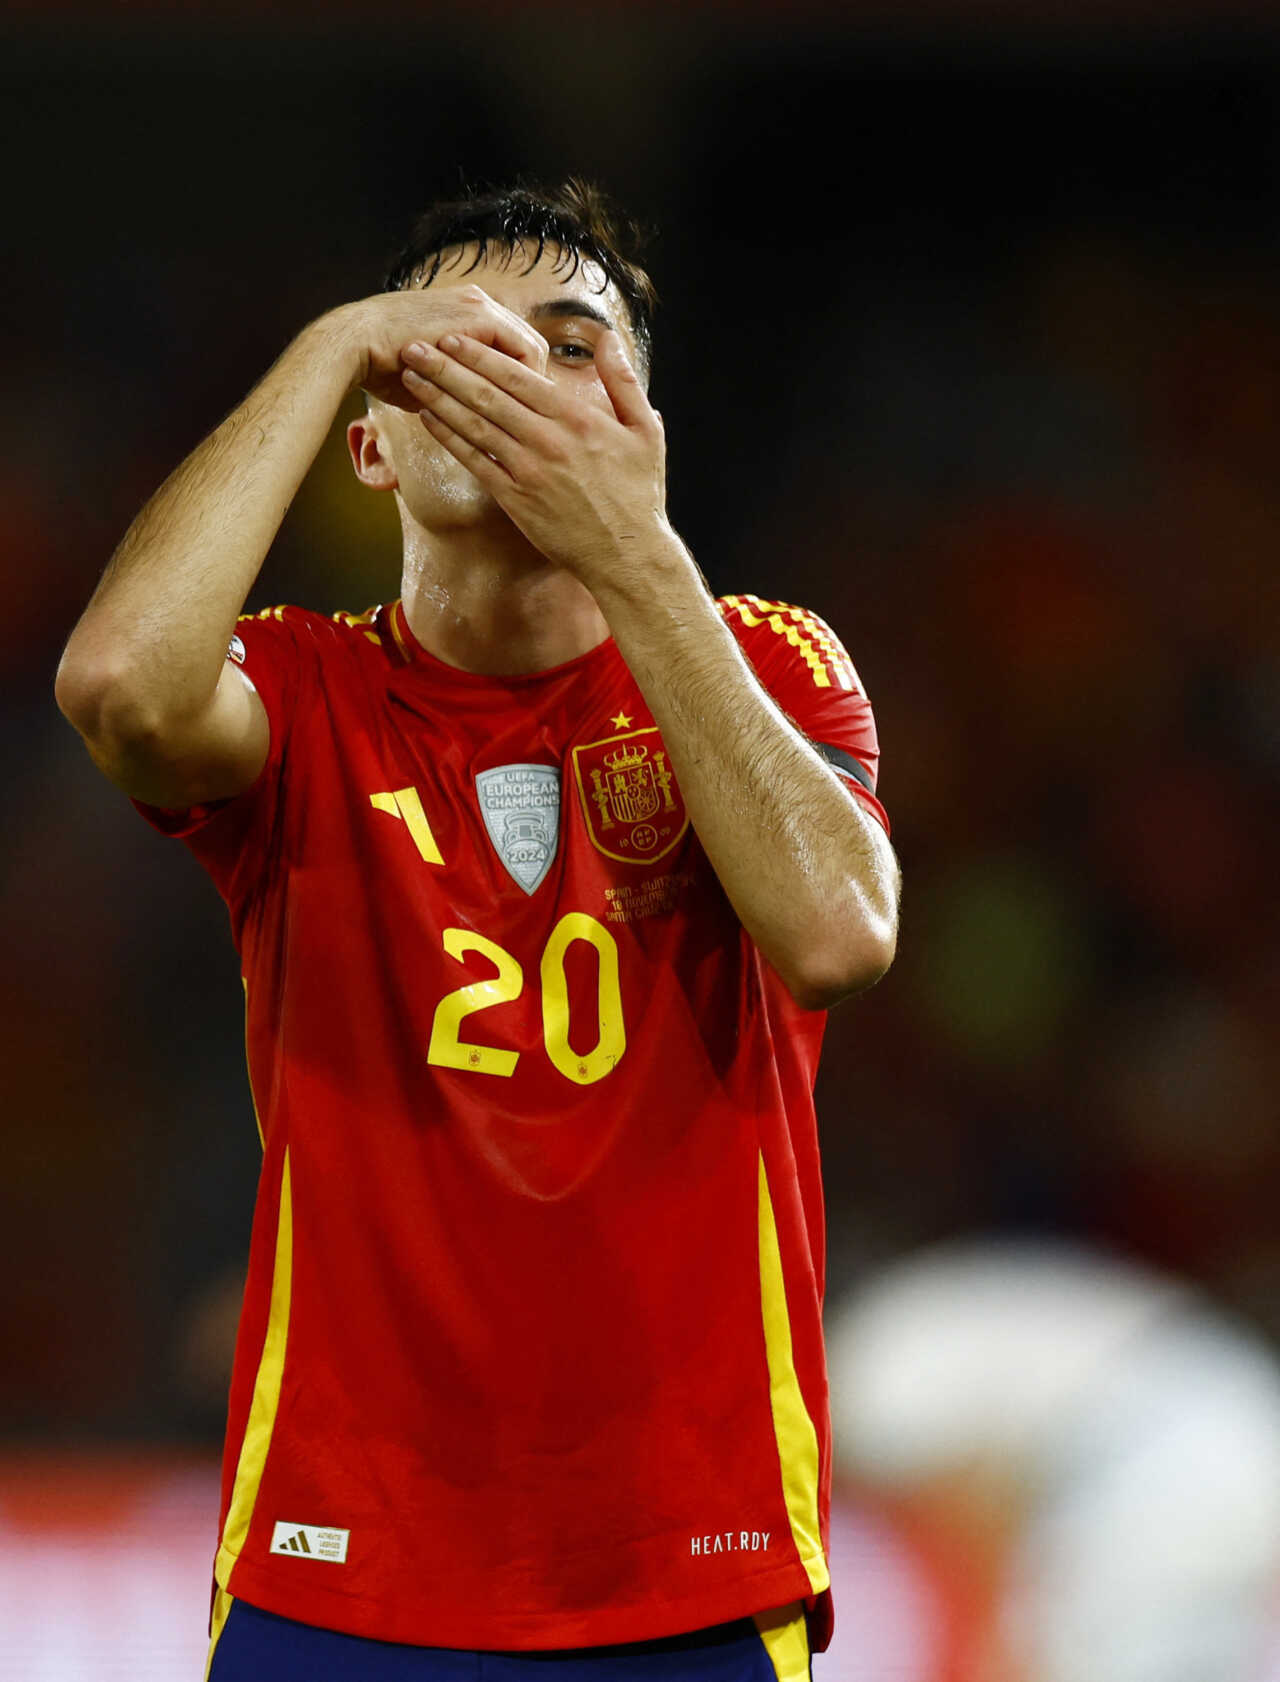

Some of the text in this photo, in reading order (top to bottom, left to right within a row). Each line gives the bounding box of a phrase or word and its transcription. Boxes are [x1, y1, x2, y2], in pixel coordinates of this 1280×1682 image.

[506, 771, 535, 781] UEFA
[486, 782, 559, 797] EUROPEAN
[487, 794, 560, 809] CHAMPIONS
[510, 849, 545, 861] 2024
[427, 912, 627, 1085] 20
[691, 1531, 770, 1556] HEAT.RDY
